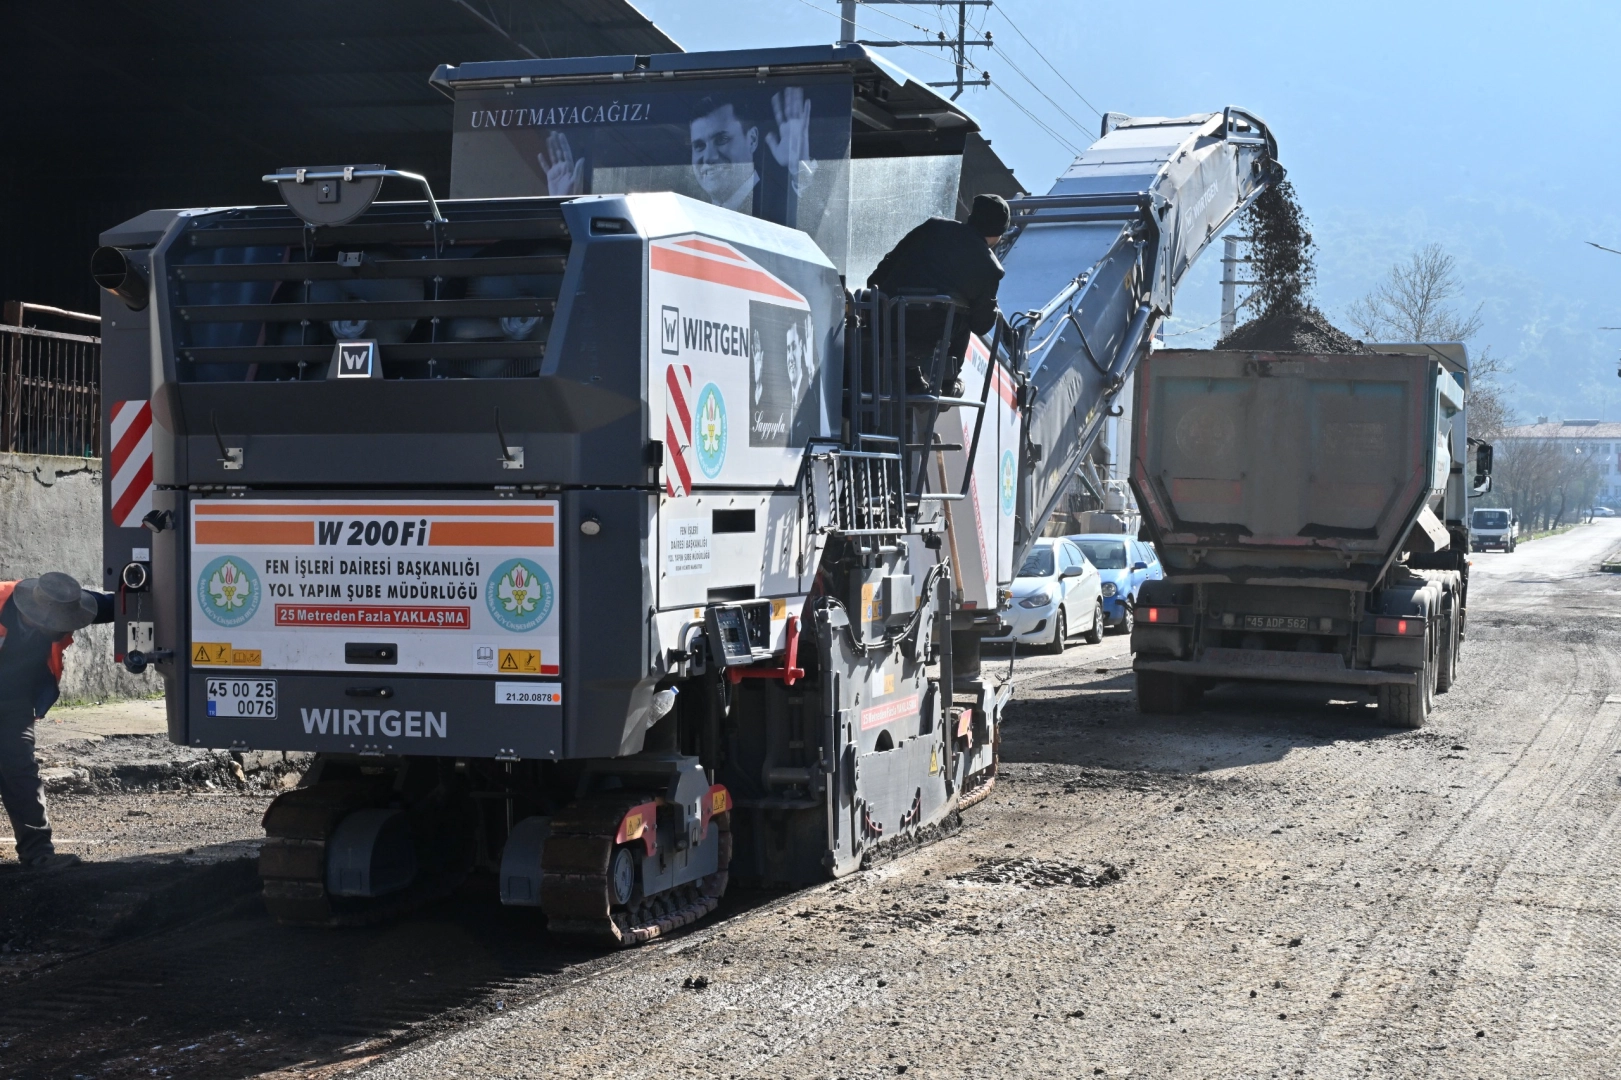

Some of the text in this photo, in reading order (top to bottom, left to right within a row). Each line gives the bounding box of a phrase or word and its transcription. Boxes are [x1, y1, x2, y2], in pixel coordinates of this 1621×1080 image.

[471, 100, 651, 128] UNUTMAYACAĞIZ!
[1193, 179, 1219, 219] WIRTGEN
[682, 316, 749, 358] WIRTGEN
[266, 556, 480, 580] FEN İŞLERİ DAİRESİ BAŞKANLIĞI
[268, 581, 478, 602] YOL YAPIM ŞUBE MÜDÜRLÜĞÜ
[280, 609, 465, 626] 25 Metreden Fazla YAKLAŞMA
[1250, 617, 1264, 627] 45
[1266, 618, 1285, 628] ADP
[209, 682, 274, 698] 45 00 25
[506, 693, 552, 702] 21.20.0878
[237, 700, 274, 715] 0076
[300, 708, 447, 738] WIRTGEN
